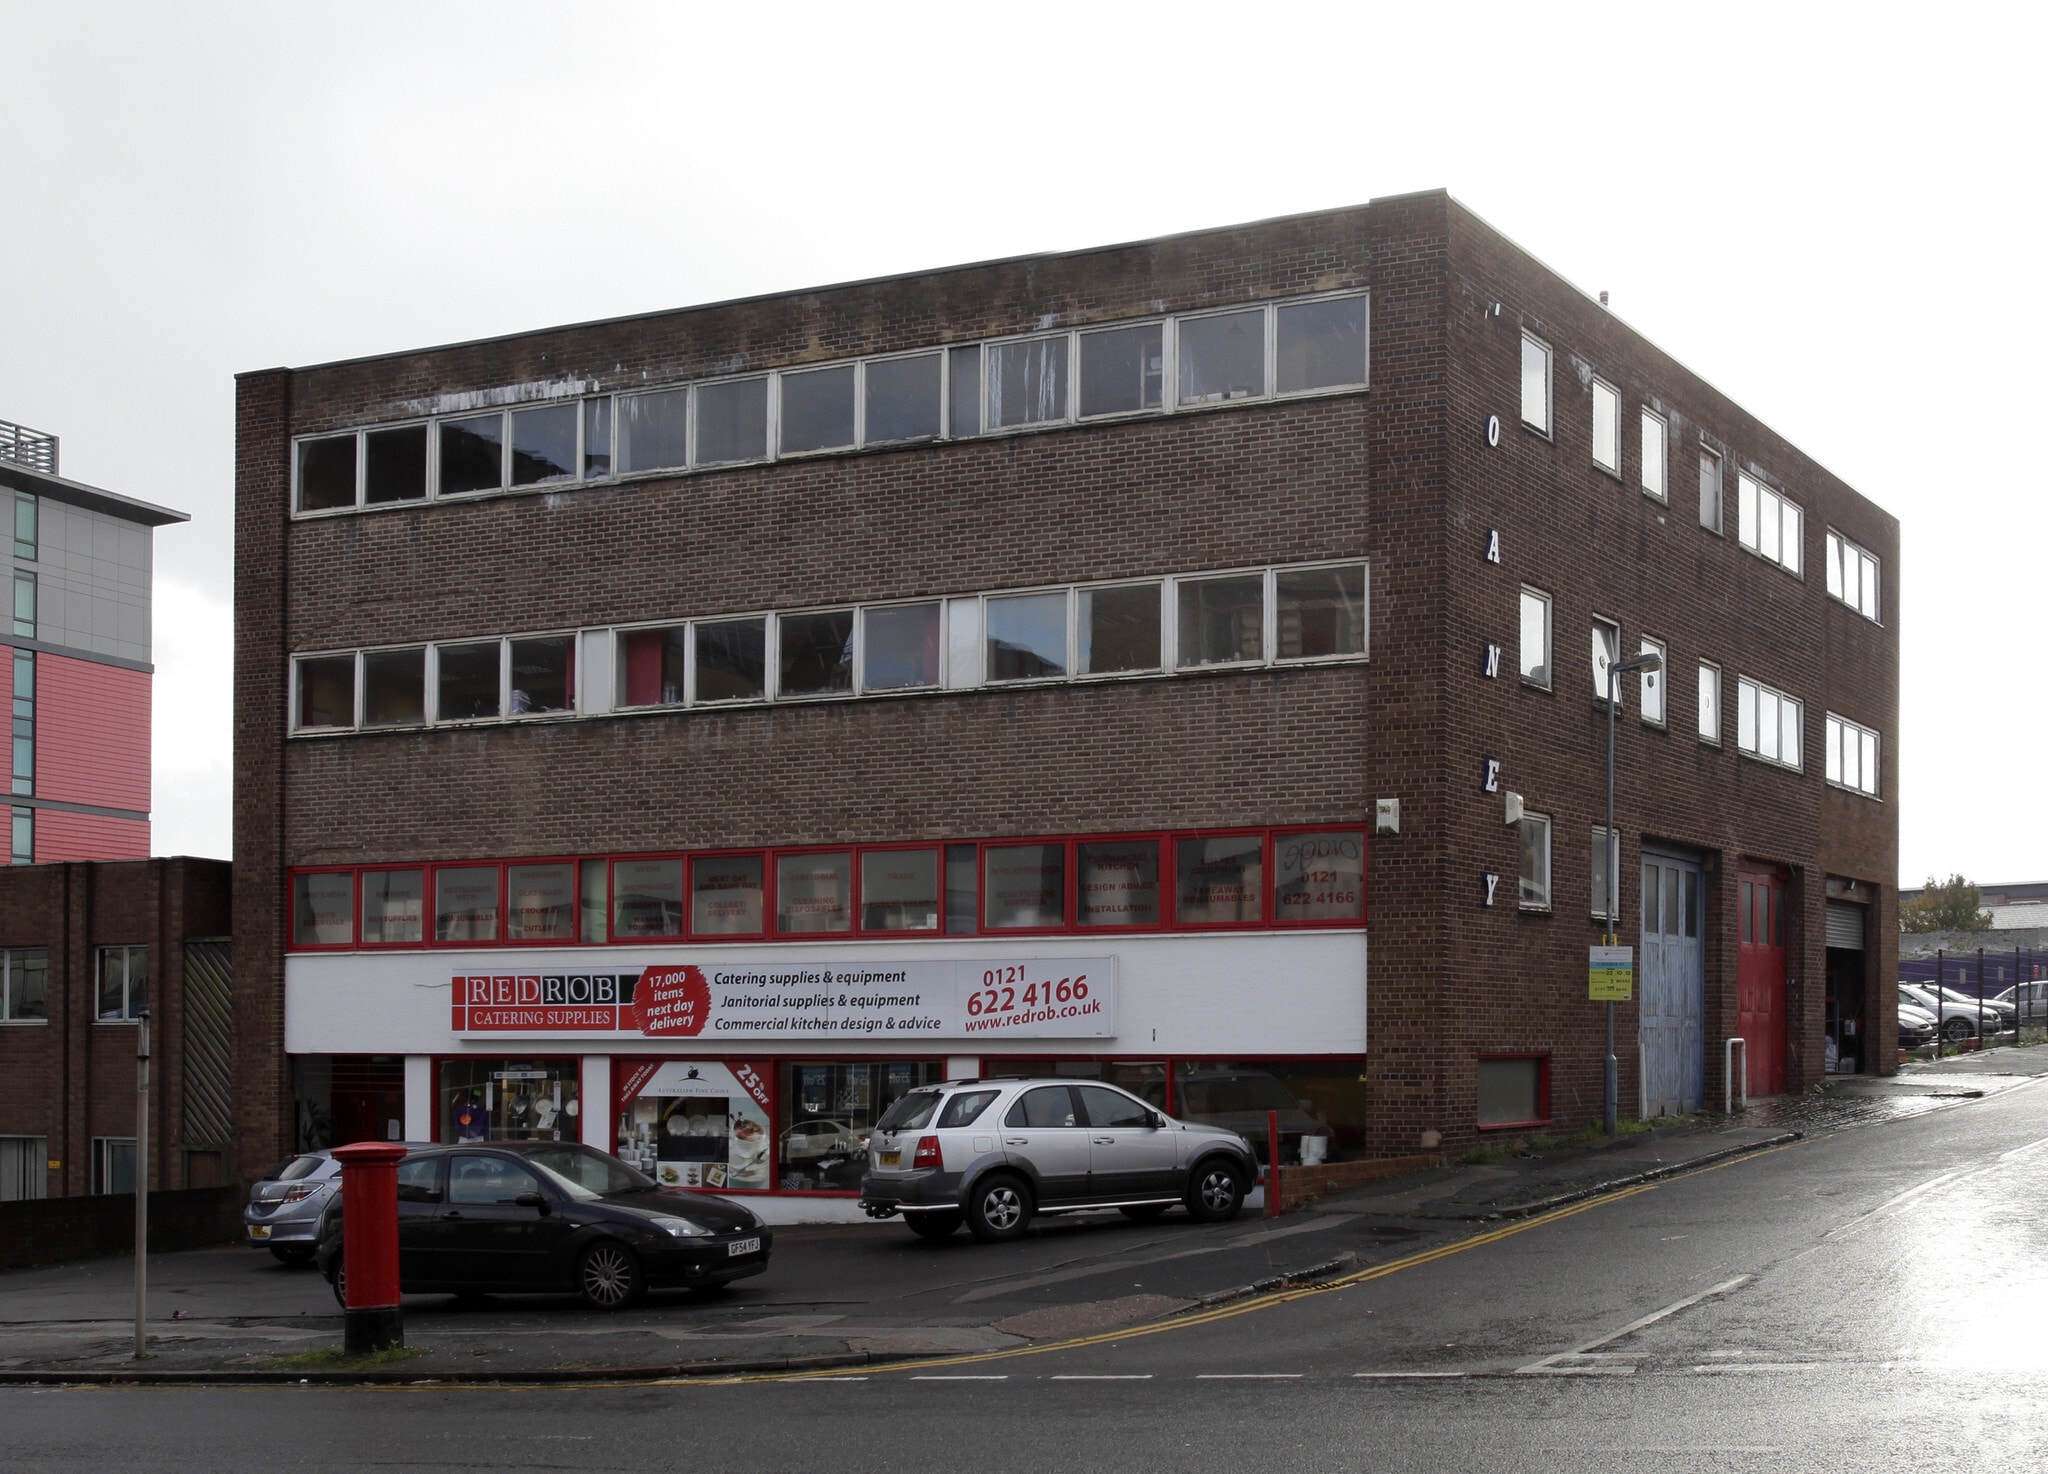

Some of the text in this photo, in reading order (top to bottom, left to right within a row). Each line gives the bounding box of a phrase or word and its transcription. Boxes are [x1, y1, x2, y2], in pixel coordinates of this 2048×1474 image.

[732, 874, 748, 882] DAY
[1302, 871, 1338, 883] 0121
[742, 881, 758, 889] DAY
[1081, 883, 1116, 891] DESIGN
[1193, 886, 1245, 894] TAKEAWAY
[792, 897, 836, 905] CLEANING
[1182, 894, 1255, 904] CONSUMABLES
[1283, 891, 1355, 905] 622 4166
[708, 909, 747, 917] DELIVERY
[786, 905, 842, 913] DISPOSABLES
[1084, 904, 1152, 913] INSTALLATION
[440, 914, 494, 922] CONSUMABLES
[649, 971, 686, 988] 17,000
[714, 970, 906, 987] Catering supplies & equipment
[983, 965, 1025, 987] 0121
[470, 977, 613, 1002] REDROB
[654, 988, 685, 1002] items
[967, 974, 1088, 1016] 622 4166
[647, 1000, 694, 1017] next day
[721, 993, 920, 1010] Janitorial supplies & equipment
[474, 1010, 611, 1025] CATERING SUPPLIES
[650, 1014, 695, 1031] delivery
[965, 999, 1101, 1032] www.redrob.co.uk
[715, 1016, 941, 1032] Commercial kitchen design & advice
[753, 1088, 769, 1104] OFF
[731, 1239, 759, 1254] GF54 YFJ
